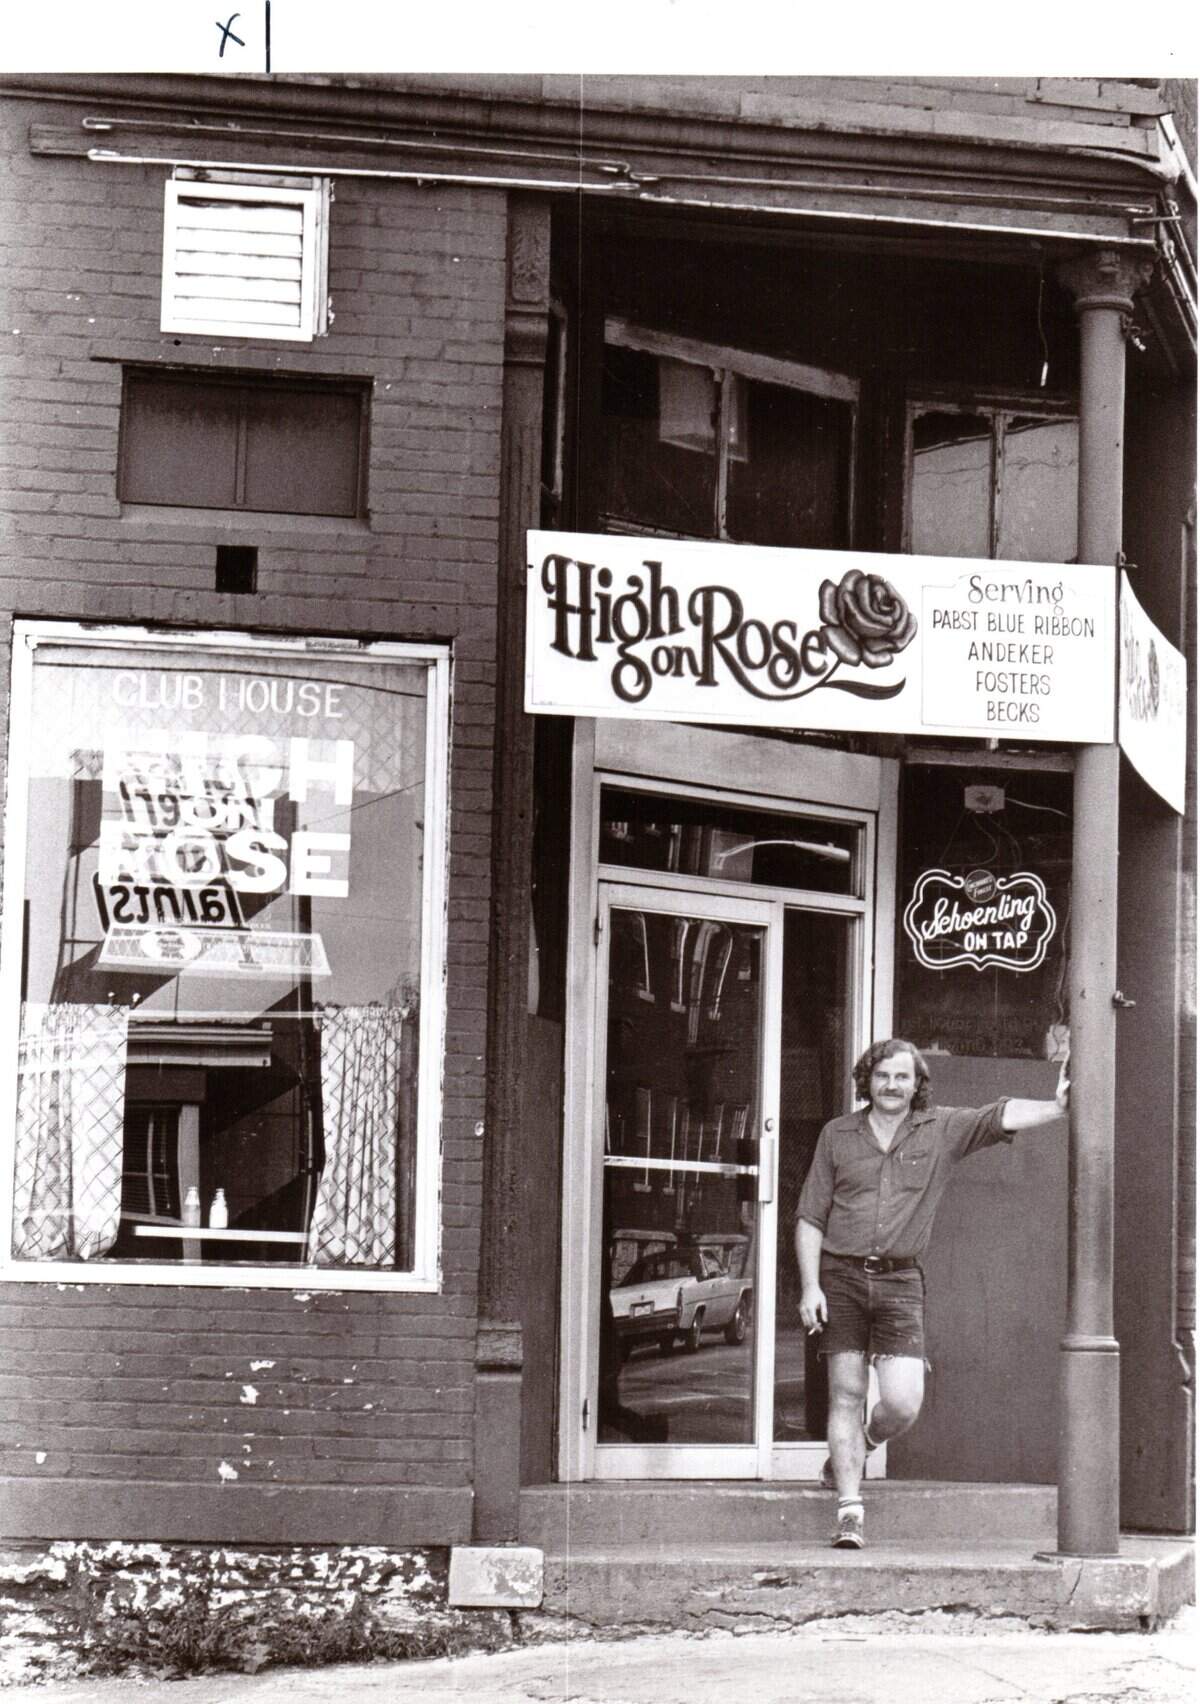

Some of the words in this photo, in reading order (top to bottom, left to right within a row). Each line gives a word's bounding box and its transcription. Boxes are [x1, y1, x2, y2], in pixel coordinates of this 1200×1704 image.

[968, 574, 1065, 616] Serving
[541, 553, 685, 703] High
[651, 645, 703, 678] on
[688, 585, 829, 701] Rose
[933, 609, 978, 631] PABST
[987, 612, 1025, 633] BLUE
[1035, 615, 1094, 638] RIBBON
[968, 641, 1054, 664] ANDEKER
[112, 672, 203, 711] CLUB
[219, 677, 346, 719] HOUSE
[976, 671, 1051, 696] FOSTERS
[987, 701, 1040, 723] BECKS
[98, 819, 351, 898] ROSE
[921, 894, 1036, 941] Schoenling
[963, 931, 987, 951] ON
[991, 931, 1028, 949] TAP
